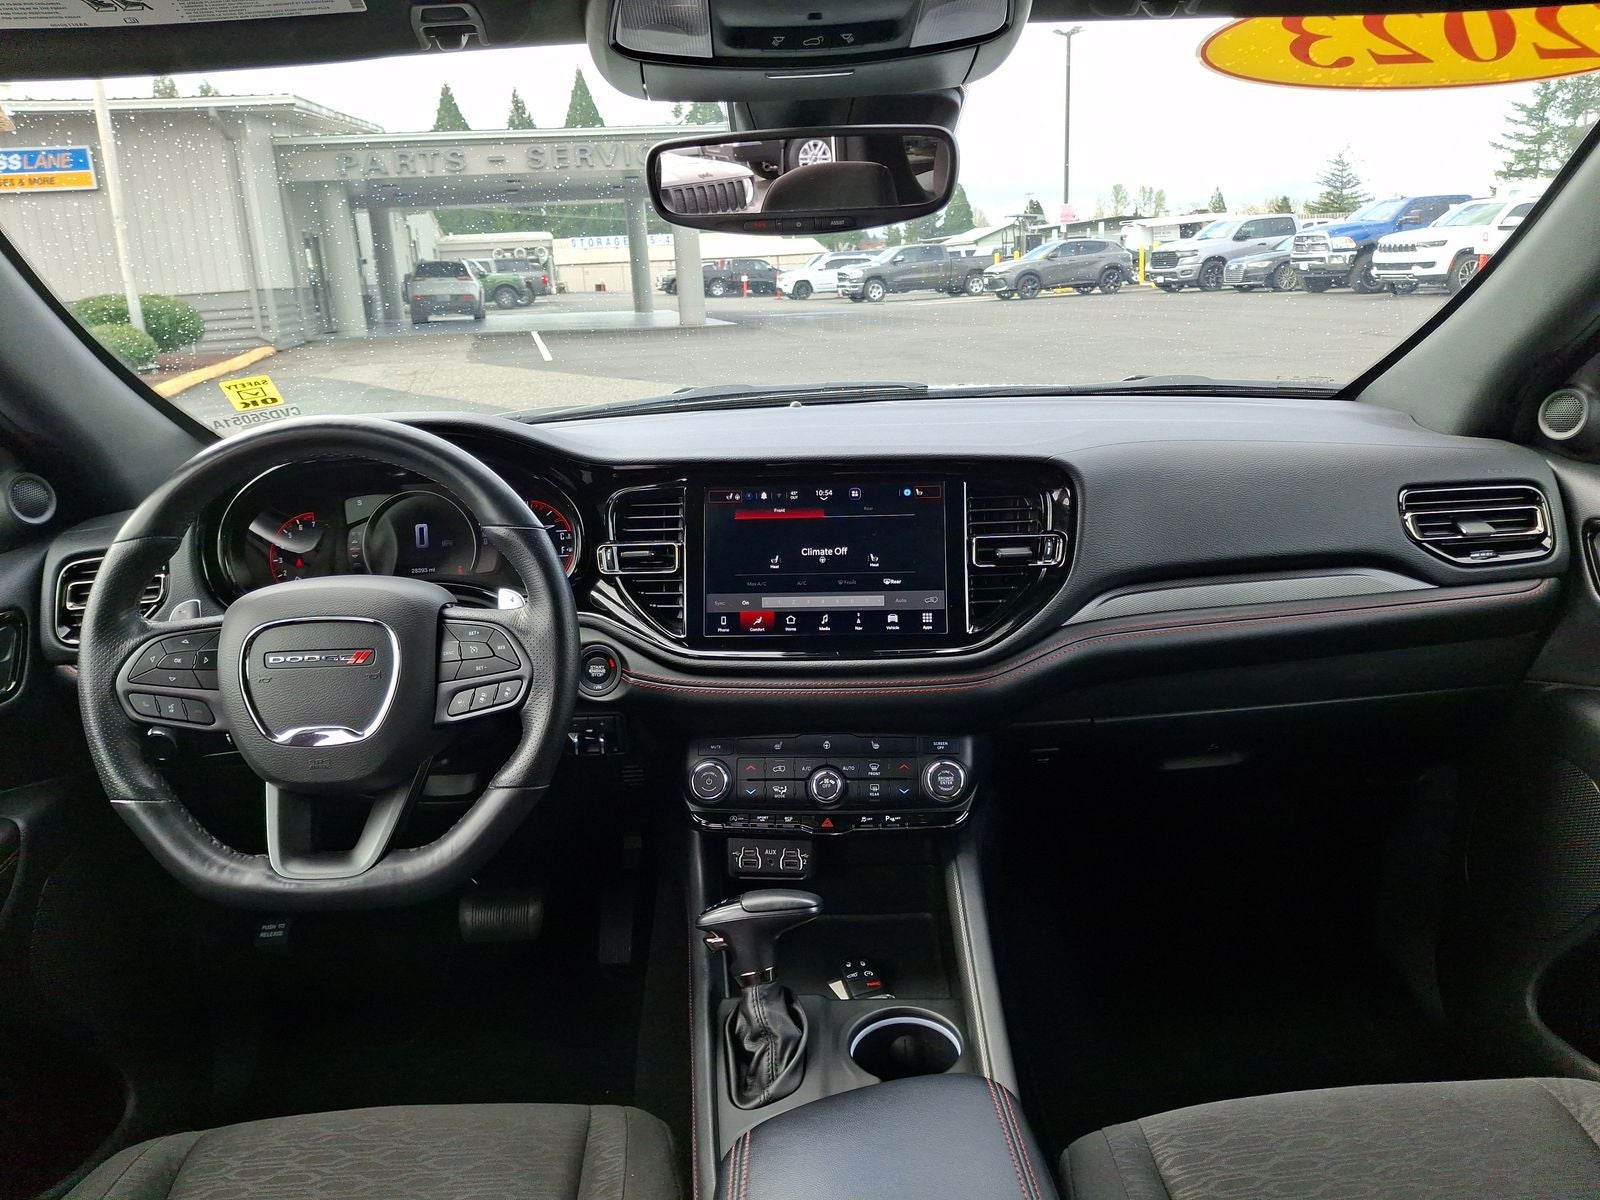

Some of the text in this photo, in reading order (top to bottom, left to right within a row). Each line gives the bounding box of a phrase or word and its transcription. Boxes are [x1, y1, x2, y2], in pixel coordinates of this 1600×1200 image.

[337, 148, 467, 176] PARTS
[28, 176, 56, 186] MORE
[570, 236, 630, 248] STORAGE
[414, 523, 429, 549] 0
[801, 546, 848, 556] Climate Off
[268, 654, 352, 664] DODGE
